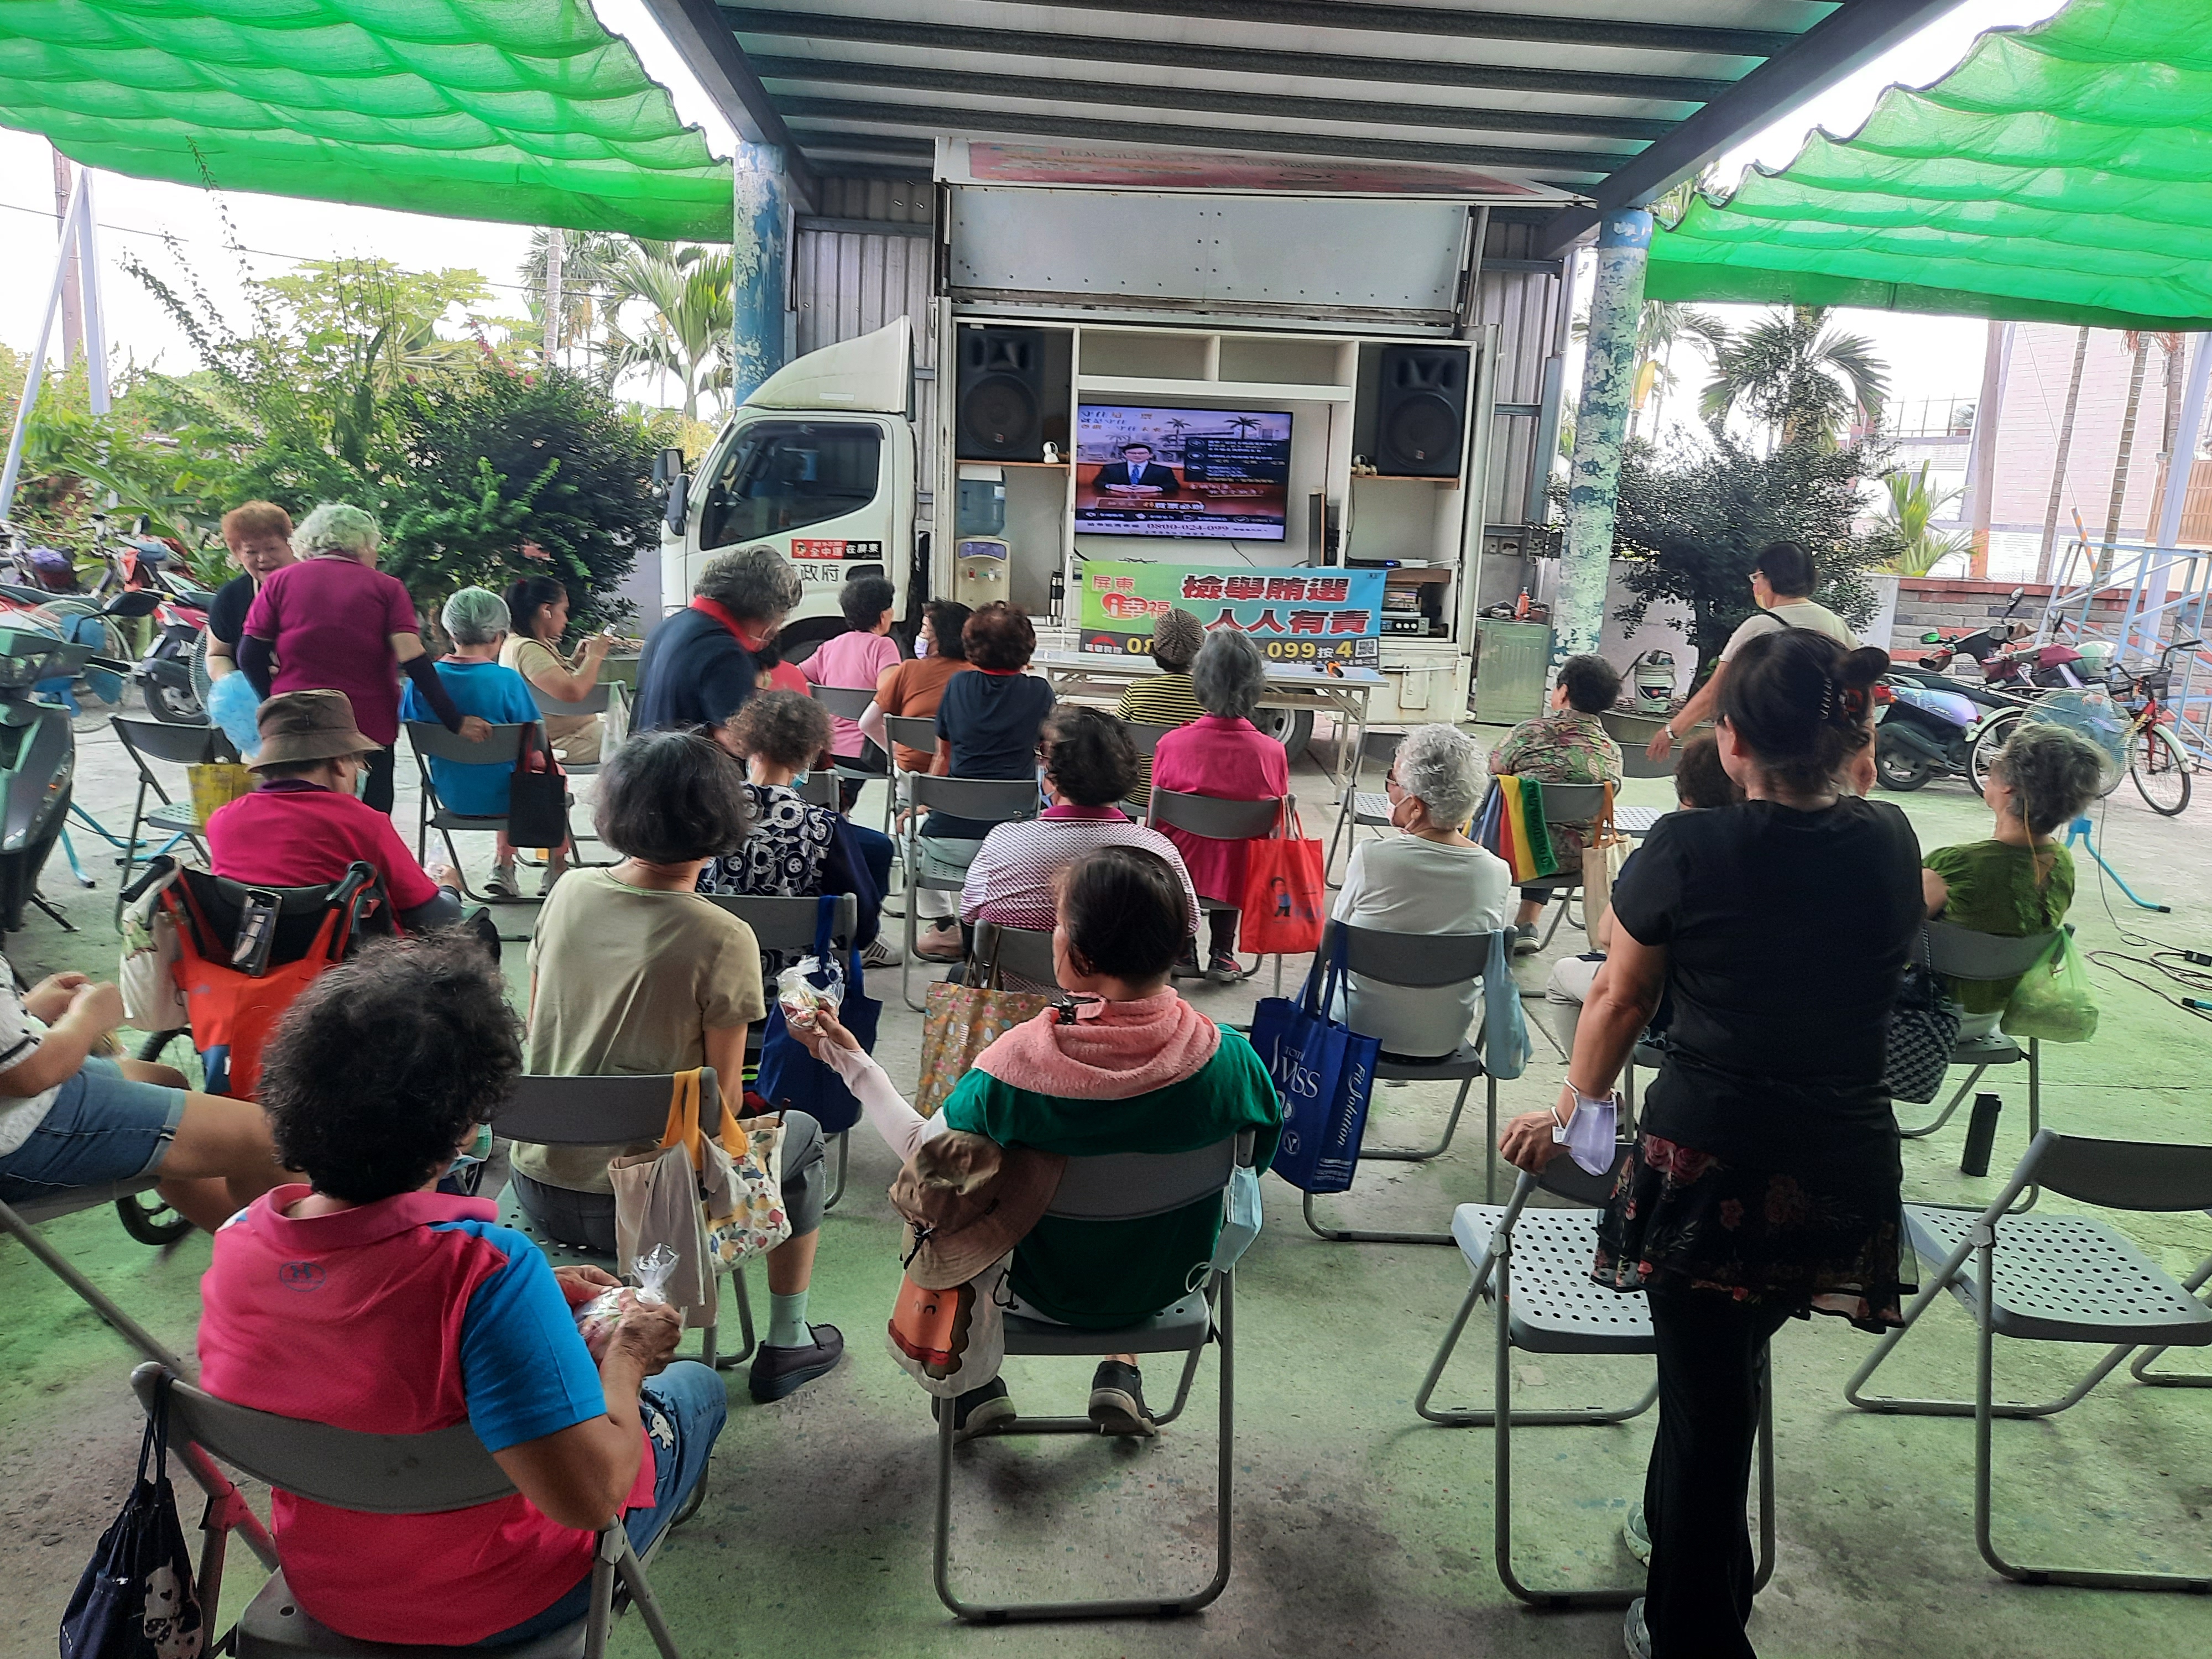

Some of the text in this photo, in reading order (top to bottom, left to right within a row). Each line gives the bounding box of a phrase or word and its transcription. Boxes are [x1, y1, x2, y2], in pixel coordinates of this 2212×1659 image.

[790, 564, 840, 582] 政府
[1092, 575, 1135, 593] 屏東
[1181, 574, 1350, 602] 檢舉賄選
[1204, 608, 1371, 634] 人人有責
